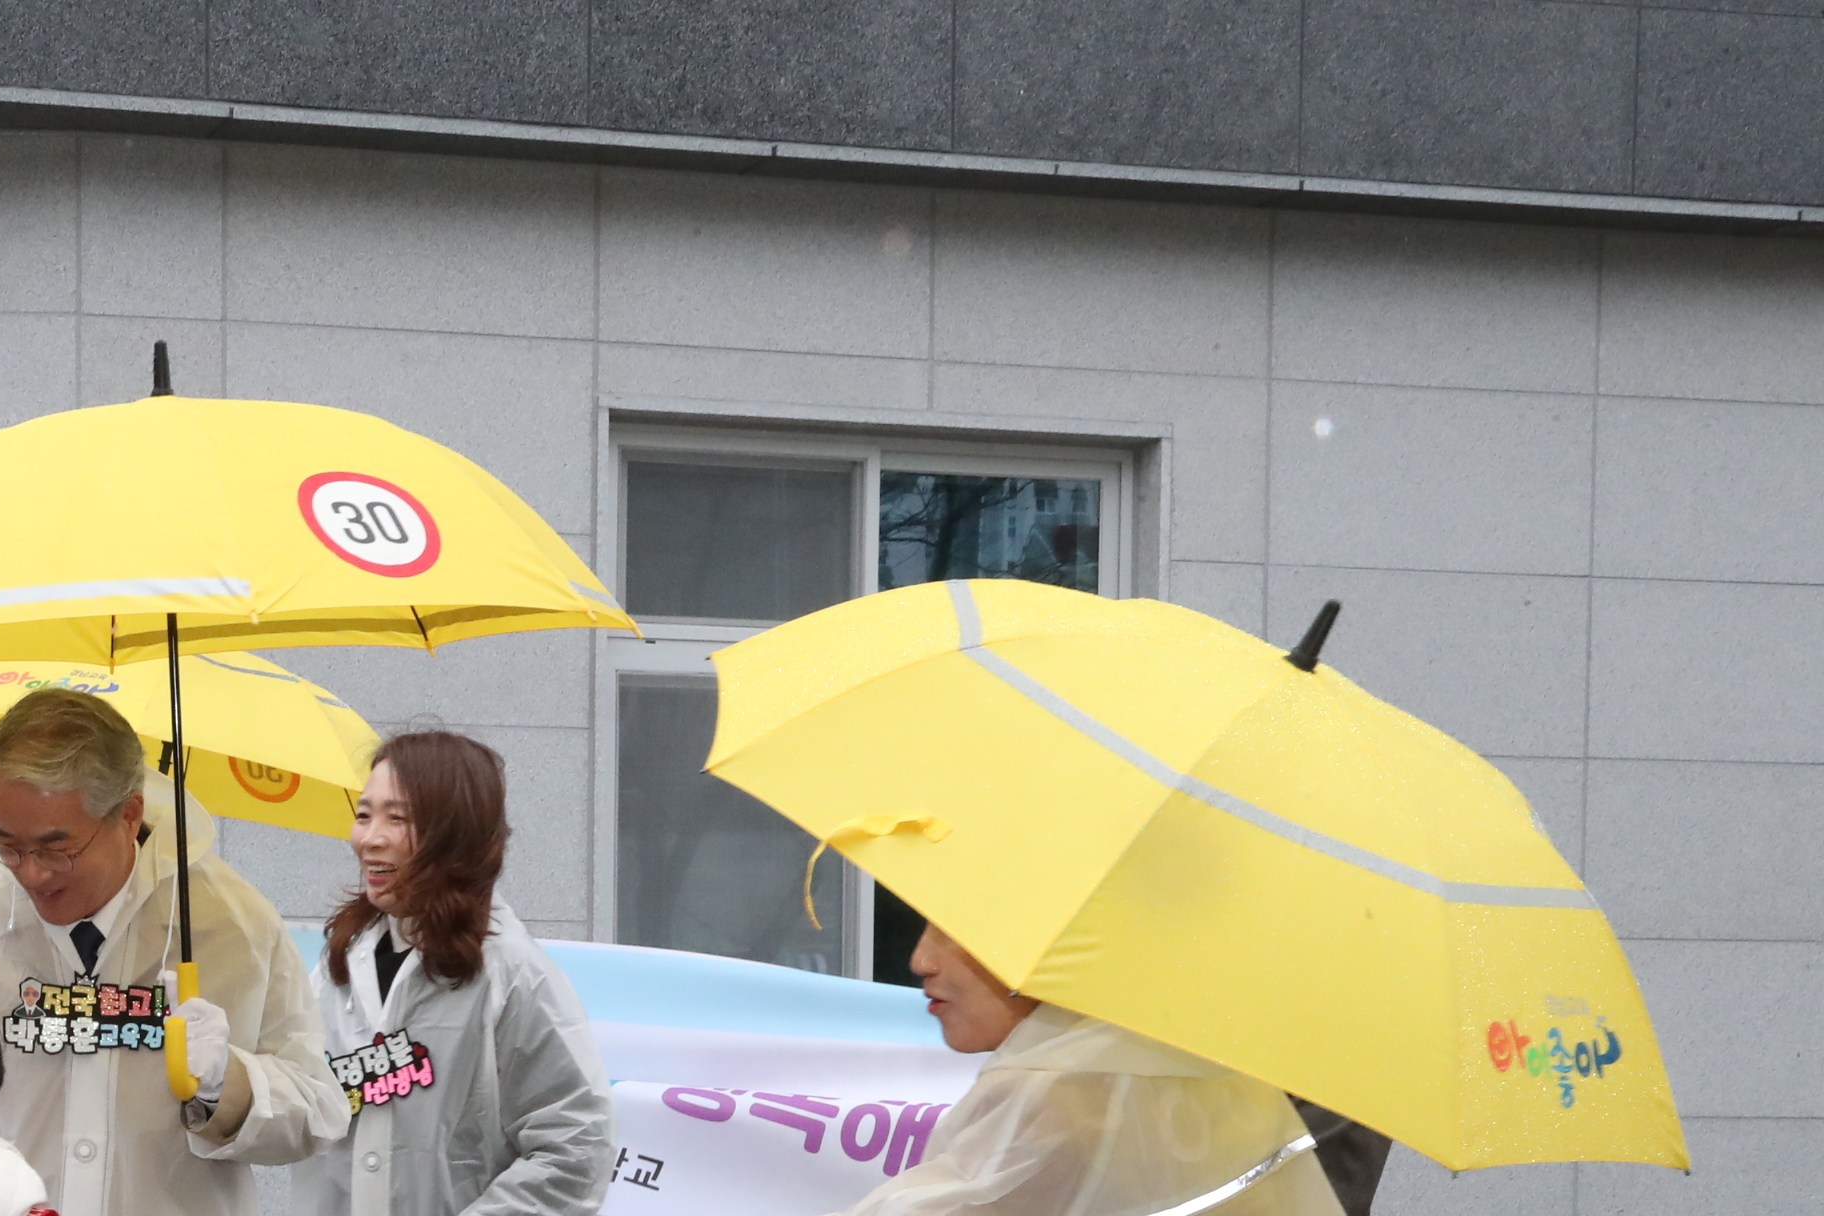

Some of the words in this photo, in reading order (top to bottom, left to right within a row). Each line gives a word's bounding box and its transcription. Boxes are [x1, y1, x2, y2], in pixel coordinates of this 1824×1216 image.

[331, 501, 409, 545] 30
[363, 1057, 433, 1105] 선생님
[1488, 1018, 1622, 1108] 아이좋아
